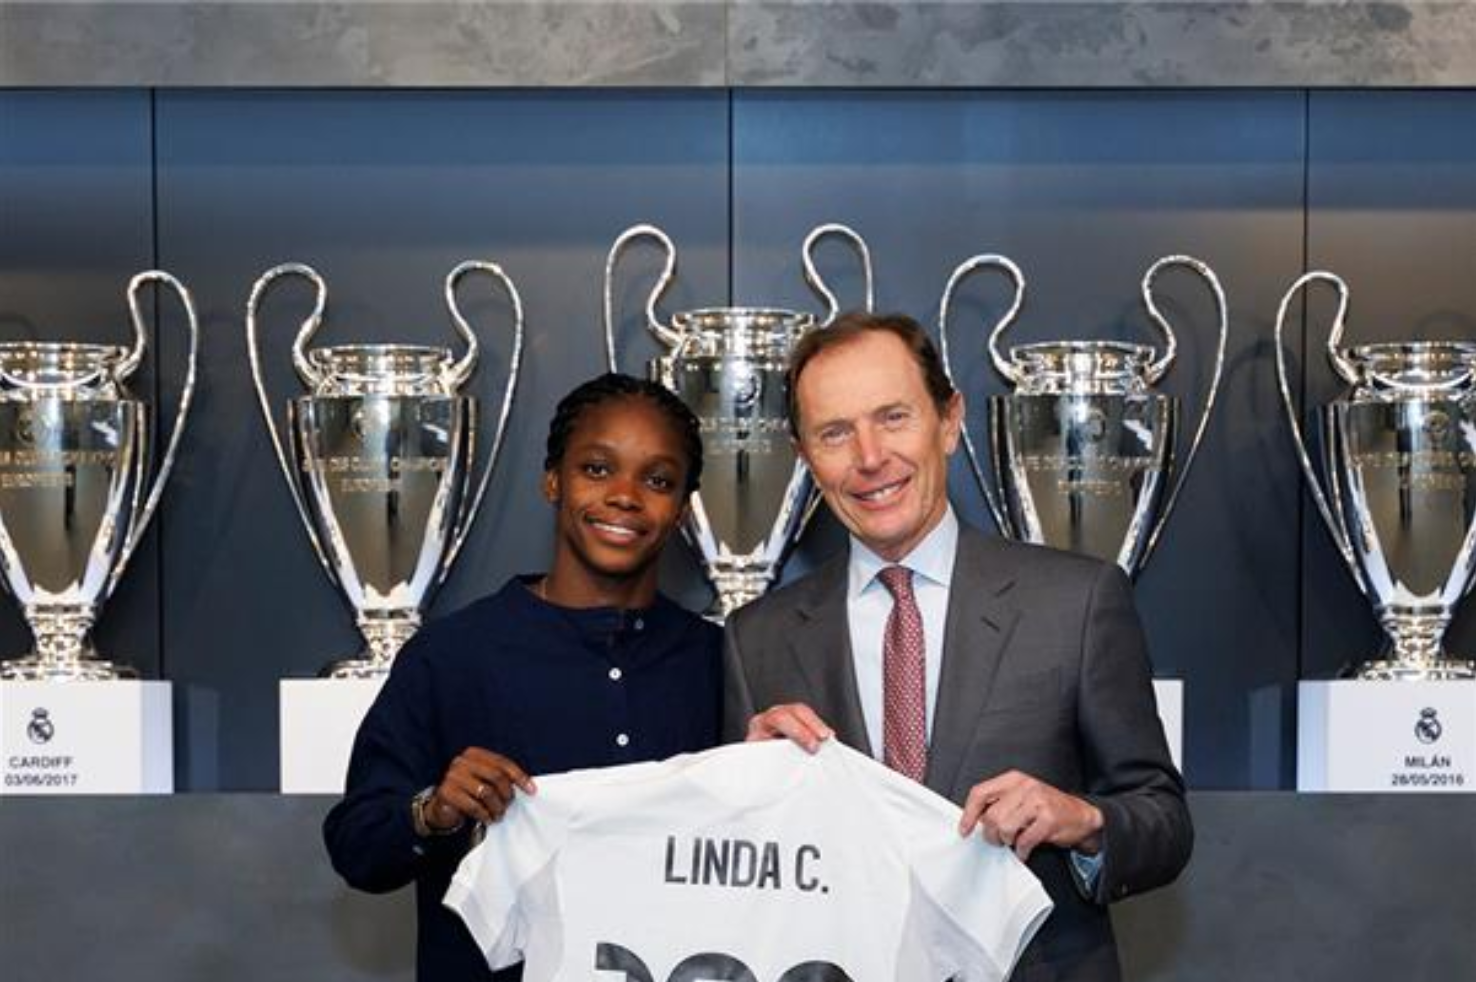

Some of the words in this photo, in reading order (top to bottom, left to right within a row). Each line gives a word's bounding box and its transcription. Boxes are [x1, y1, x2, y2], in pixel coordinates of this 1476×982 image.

[9, 756, 72, 768] CARDIFF
[664, 836, 781, 891] LINDA
[794, 844, 830, 895] C.
